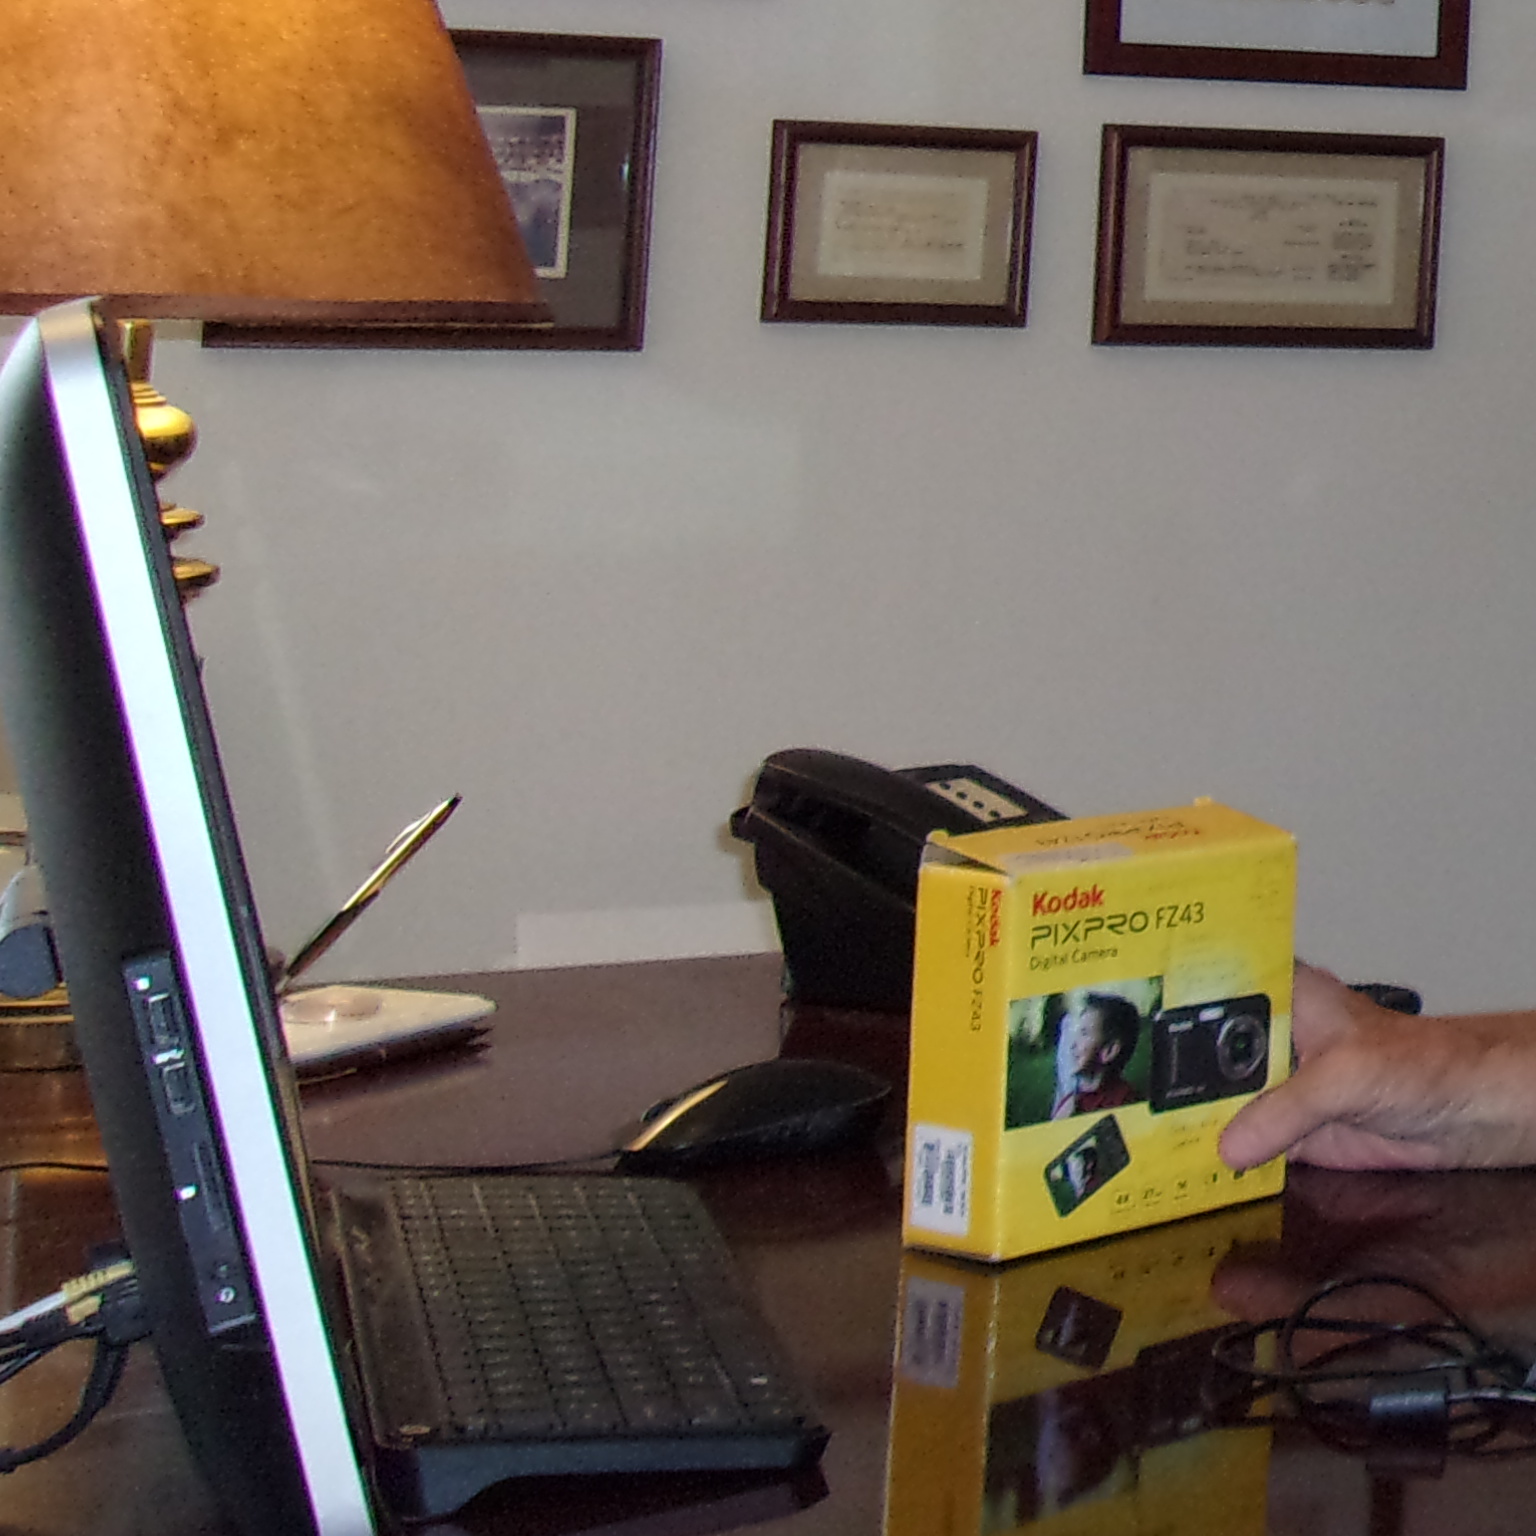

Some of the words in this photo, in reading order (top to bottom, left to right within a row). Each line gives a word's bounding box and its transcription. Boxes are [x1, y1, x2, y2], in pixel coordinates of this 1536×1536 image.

[990, 888, 1002, 947] Kodak
[1032, 884, 1105, 917] Kodak
[972, 886, 987, 985] PIXPRO
[1030, 910, 1149, 950] PIXPRO
[1155, 901, 1205, 932] FZ43
[1030, 949, 1069, 972] Digital
[1071, 945, 1118, 964] Camera
